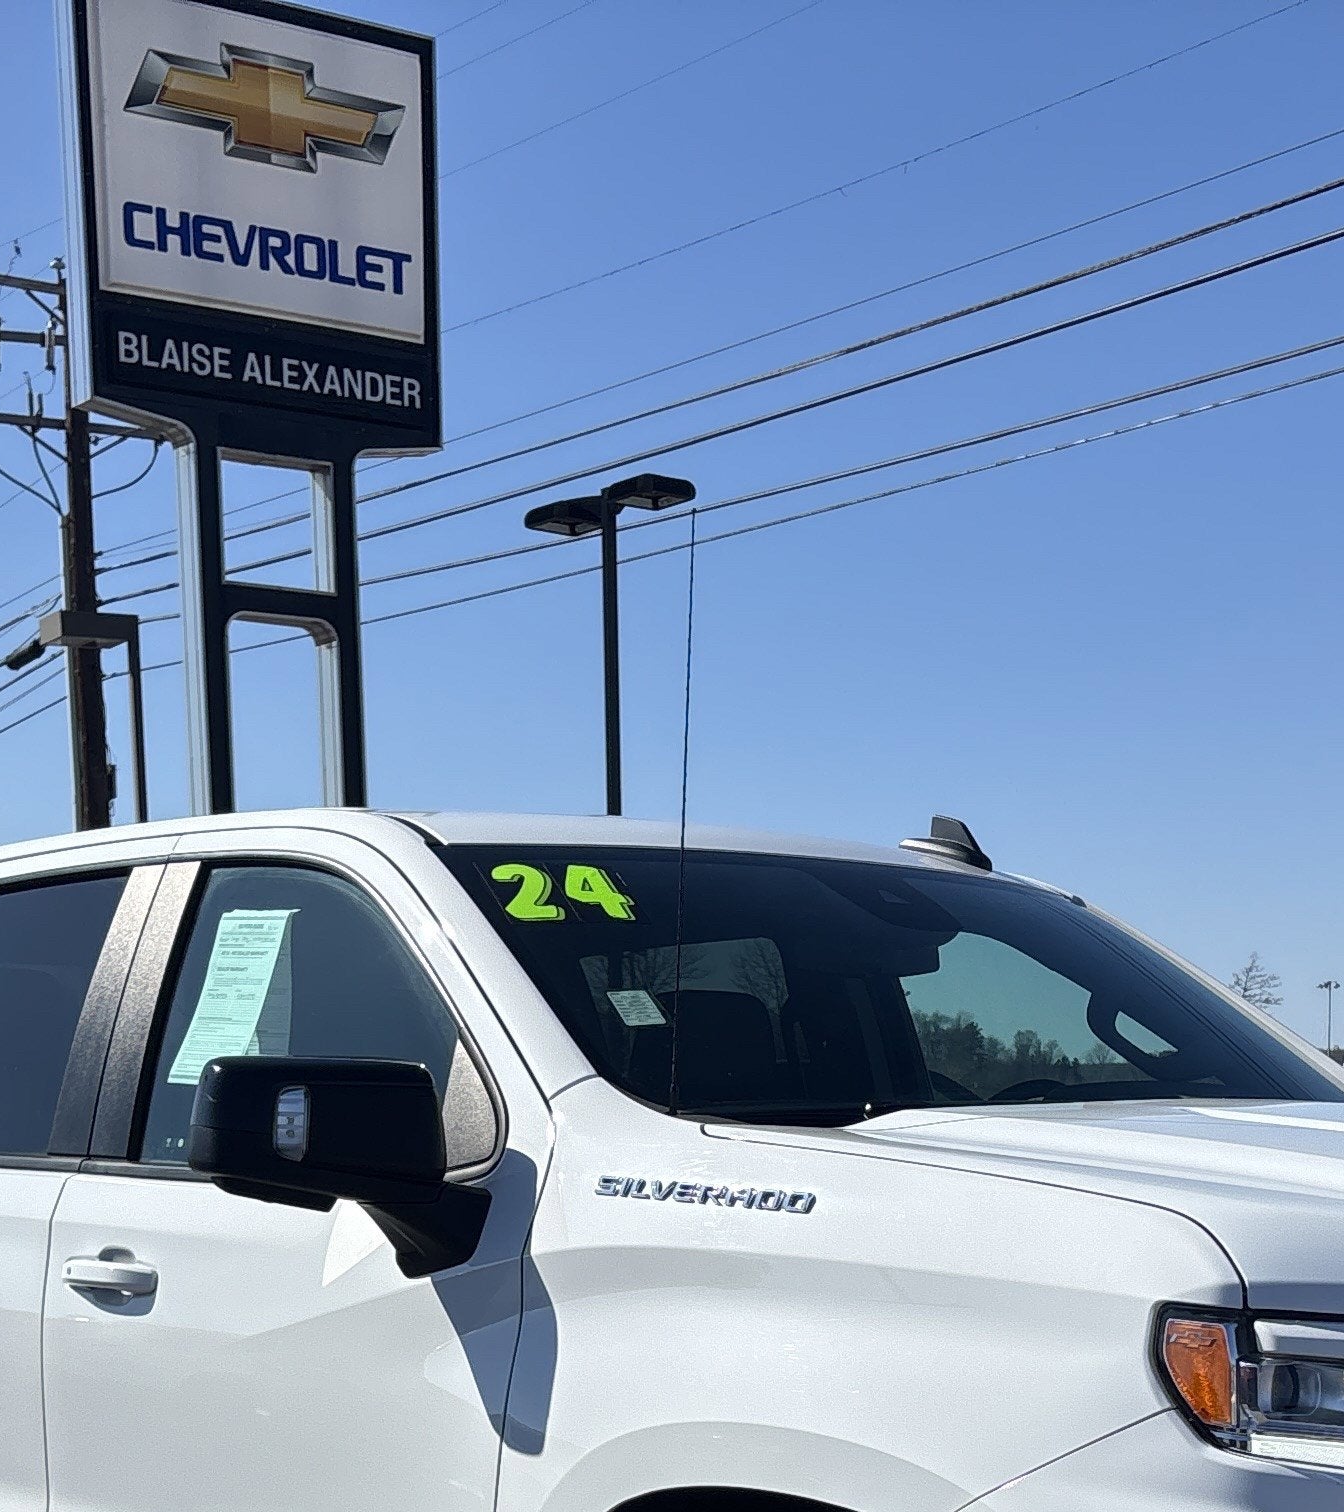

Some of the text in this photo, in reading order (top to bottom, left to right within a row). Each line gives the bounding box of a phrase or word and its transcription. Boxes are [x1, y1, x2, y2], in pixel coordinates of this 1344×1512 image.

[122, 201, 412, 294] CHEVROLET
[118, 331, 422, 410] BLAISE ALEXANDER
[491, 863, 637, 922] 24
[594, 1175, 817, 1214] SILVERADO
